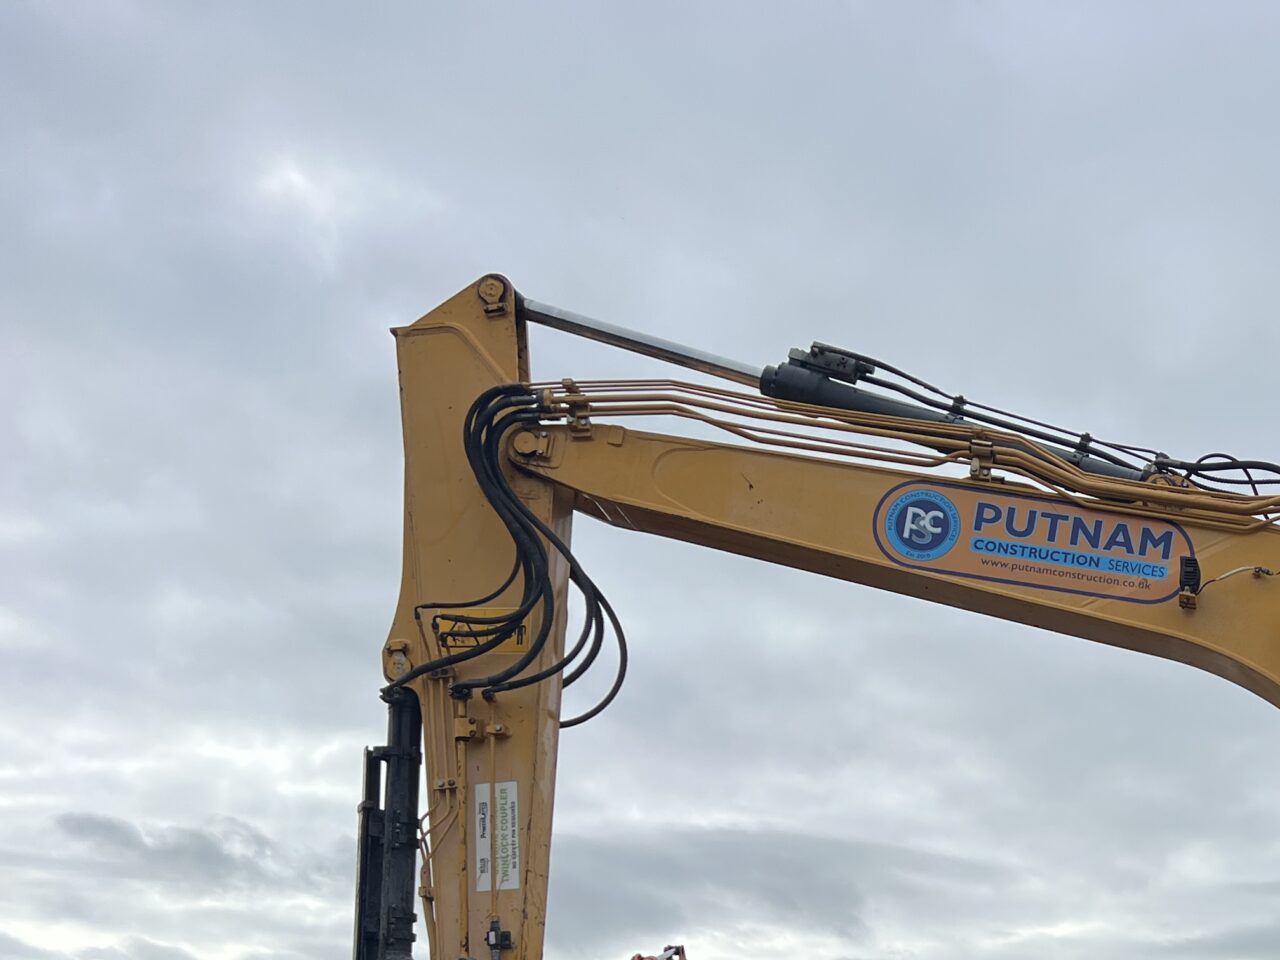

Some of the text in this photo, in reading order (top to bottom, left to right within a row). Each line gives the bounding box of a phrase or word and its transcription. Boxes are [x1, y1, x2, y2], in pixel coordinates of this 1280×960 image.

[974, 502, 1173, 560] PUTNAM
[974, 539, 1165, 578] CONSTRUCTION SERVICES
[500, 788, 510, 883] TWINLOCK COUPLER
